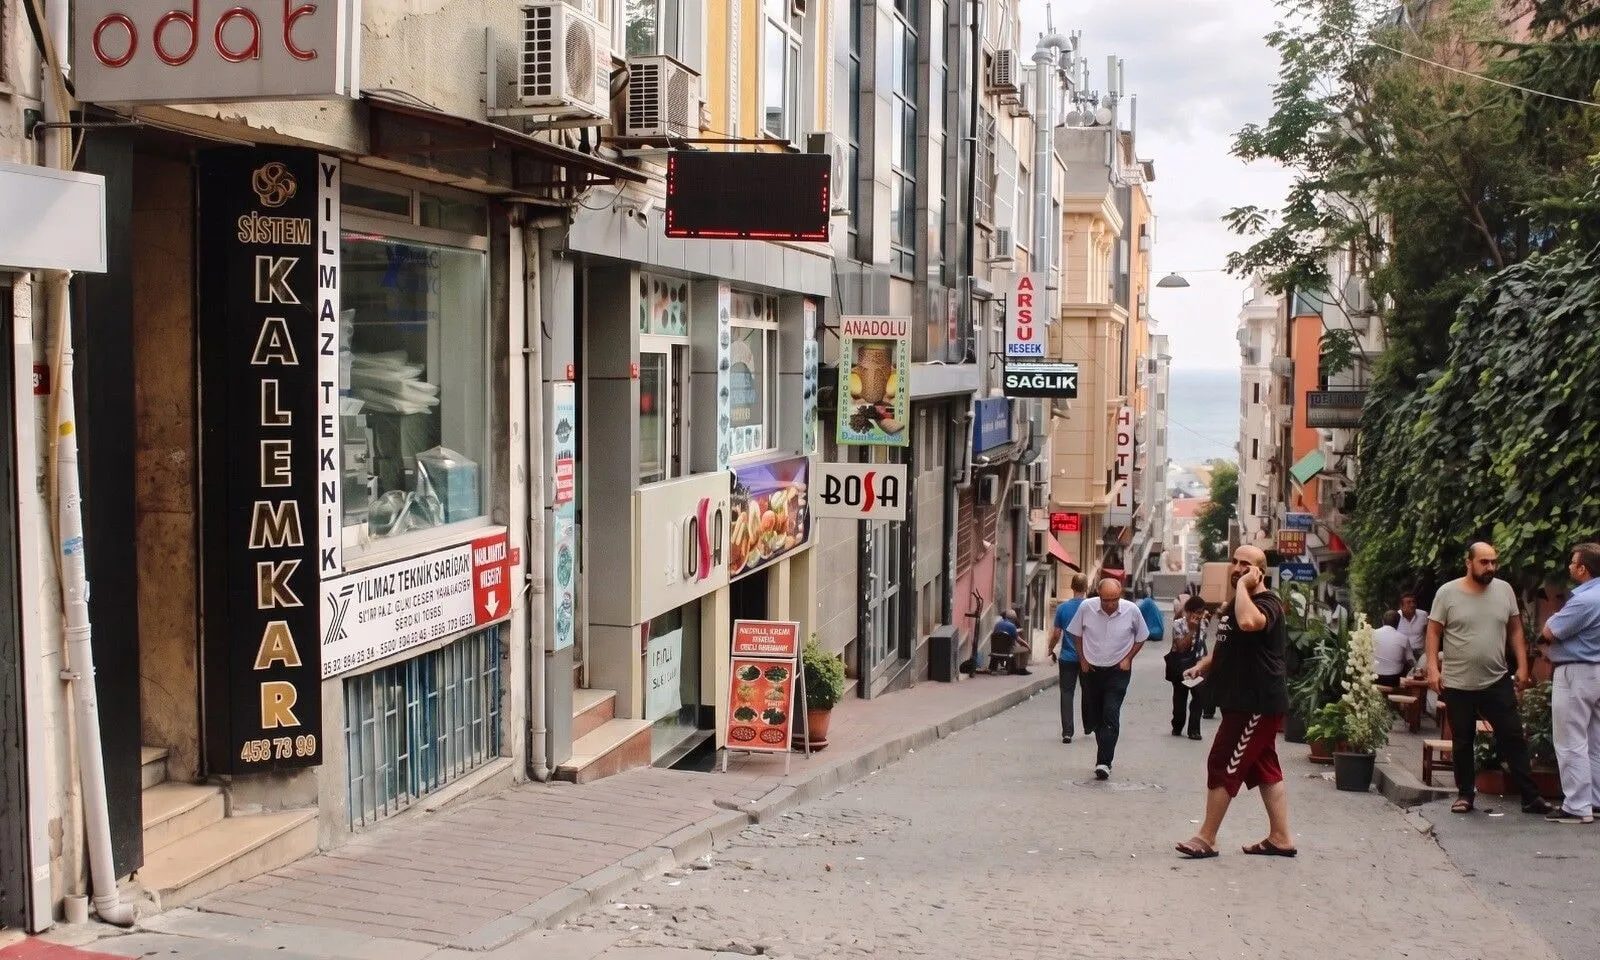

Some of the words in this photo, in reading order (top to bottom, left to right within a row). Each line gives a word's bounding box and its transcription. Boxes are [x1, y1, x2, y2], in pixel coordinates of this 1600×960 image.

[238, 211, 311, 245] SİSTEM
[320, 162, 336, 356] YILMAZ
[843, 320, 907, 336] ANADOLU
[1017, 277, 1034, 341] ARSU
[1006, 373, 1077, 389] SAĞLIK
[249, 255, 304, 729] KALEMKAR
[320, 381, 336, 571] TEKNİK
[820, 471, 899, 512] BOSA
[356, 572, 396, 604] YİLMAZ
[398, 562, 433, 593] TEKNİK
[241, 738, 271, 762] 458
[273, 737, 293, 759] 73
[296, 734, 316, 757] 99
